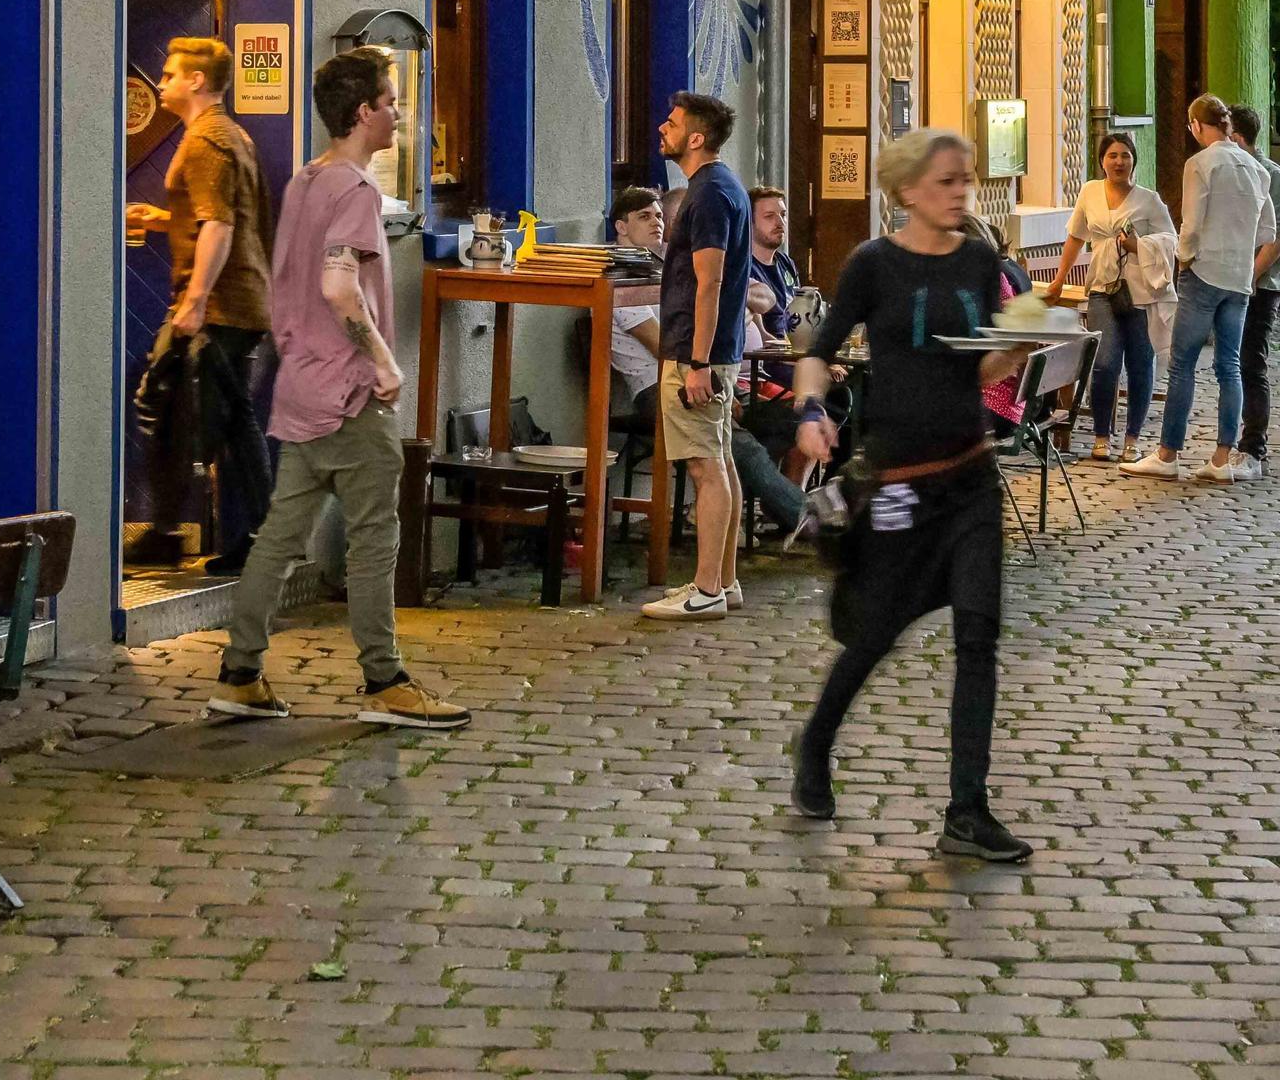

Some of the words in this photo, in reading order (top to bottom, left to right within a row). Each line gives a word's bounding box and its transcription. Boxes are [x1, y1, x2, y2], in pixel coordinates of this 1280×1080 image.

[244, 37, 277, 52] alt
[243, 54, 281, 67] SAX
[246, 70, 280, 81] neu
